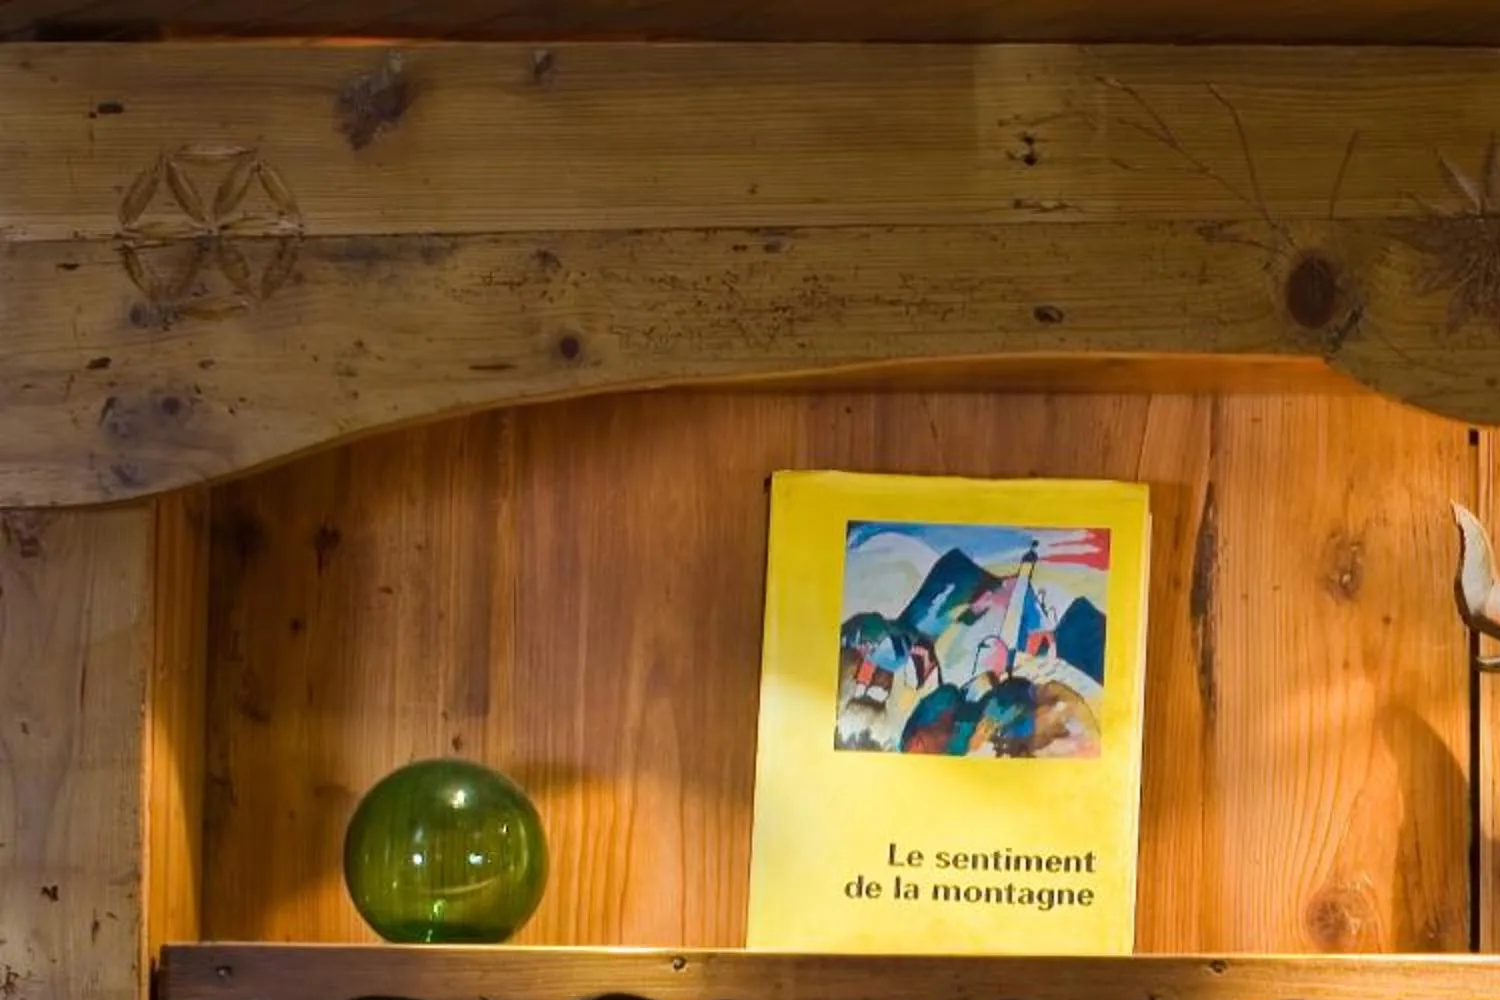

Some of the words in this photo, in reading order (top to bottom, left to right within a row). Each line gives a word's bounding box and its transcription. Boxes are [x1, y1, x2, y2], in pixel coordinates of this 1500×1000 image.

[887, 842, 925, 868] Le
[935, 847, 1096, 874] sentiment
[844, 874, 883, 900] de
[893, 875, 920, 901] la
[931, 882, 1095, 911] montagne
